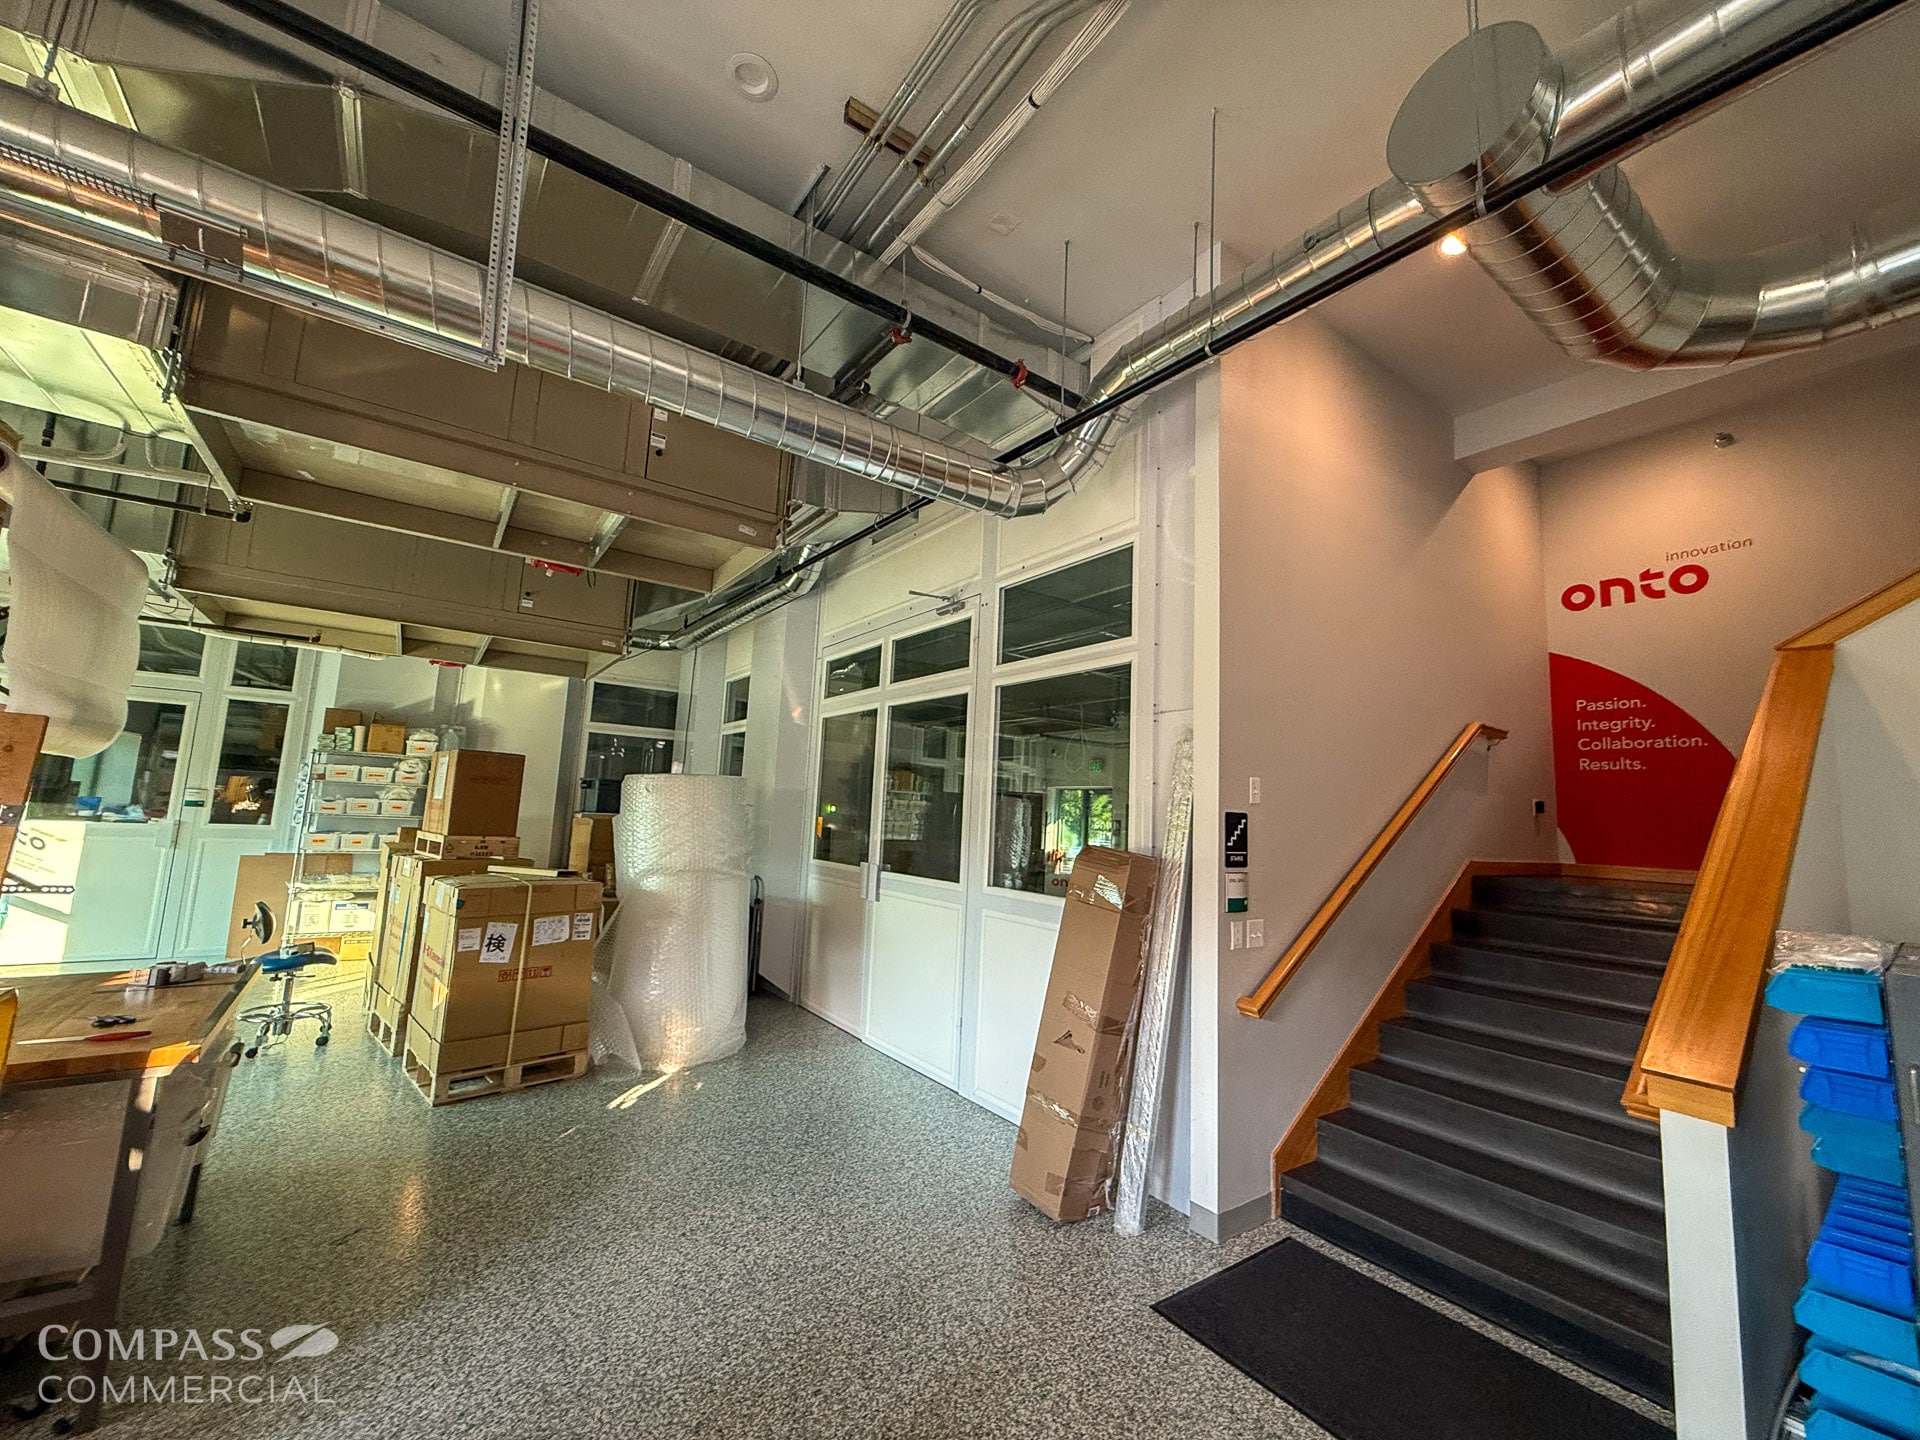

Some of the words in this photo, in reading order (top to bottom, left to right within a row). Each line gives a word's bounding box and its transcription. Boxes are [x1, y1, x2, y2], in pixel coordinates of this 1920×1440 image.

[1665, 537, 1753, 562] innovation
[1561, 564, 1709, 611] onto
[1576, 697, 1647, 711] Passion.
[1577, 717, 1656, 732] Integrity.
[1577, 735, 1709, 751] Collaboration.
[1579, 757, 1647, 771] Results.
[485, 933, 507, 953] 検
